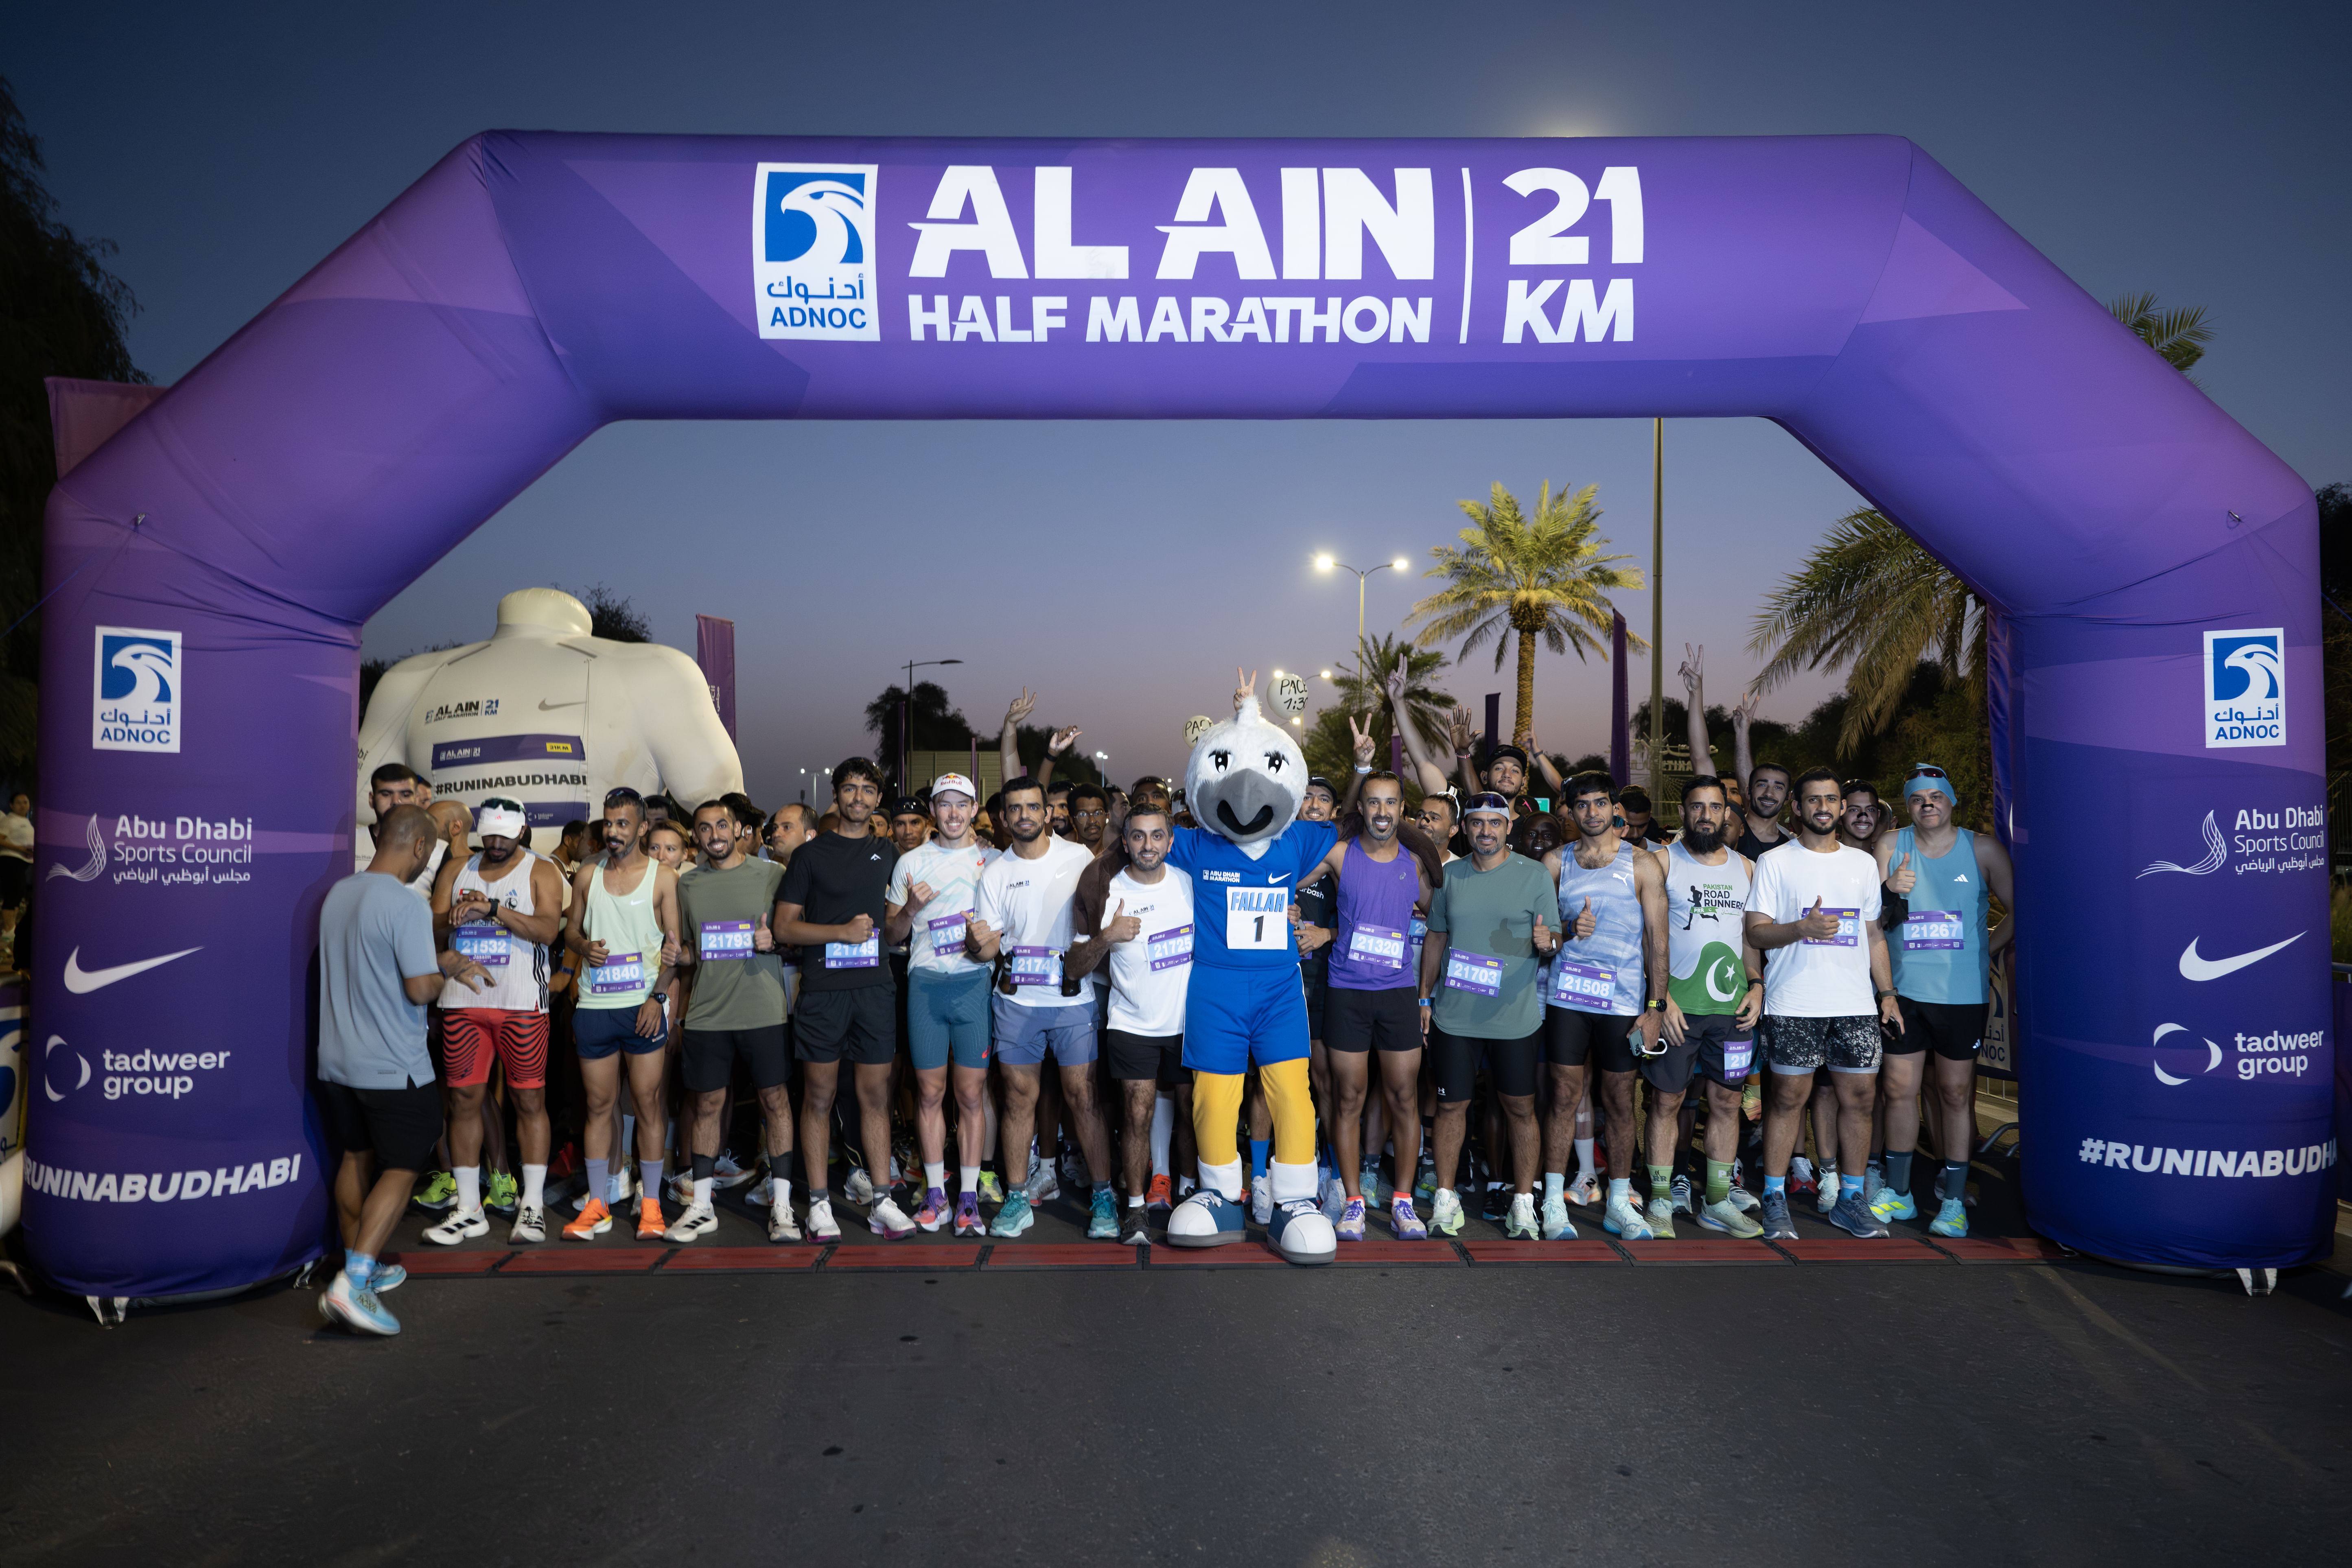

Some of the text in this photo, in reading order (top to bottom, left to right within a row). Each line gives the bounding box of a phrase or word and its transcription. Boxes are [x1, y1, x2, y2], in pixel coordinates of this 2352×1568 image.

[907, 166, 1433, 281] AL AIN
[1501, 166, 1644, 265] 21
[766, 271, 866, 304] أدنوك
[770, 306, 867, 330] ADNOC
[908, 295, 1433, 344] HALF MARATHON
[1502, 278, 1634, 344] KM
[454, 701, 480, 712] AIN
[486, 698, 499, 709] 21
[2214, 703, 2280, 725] أدنوك
[100, 707, 171, 728] أدنوك
[100, 727, 171, 745] ADNOC
[2214, 724, 2280, 740] ADNOC
[435, 774, 586, 795] #RUNINABUDHABI
[114, 814, 253, 841] Abu Dhabi
[2234, 805, 2324, 831] Abu Dhabi
[114, 841, 252, 864] Sports Council
[2234, 831, 2324, 856] Sports Council
[2235, 853, 2325, 875] مجلس أبوظبي الرياضي
[113, 866, 251, 886] مجلس أبوظبي الرياضي
[1230, 891, 1286, 912] FALLAH
[1704, 890, 1730, 899] ROAD
[1704, 899, 1744, 910] RUNNERS
[937, 925, 966, 944] 218
[1254, 915, 1264, 943] 1
[1911, 923, 1960, 938] 21267
[461, 939, 507, 954] 21532
[708, 933, 752, 948] 21793
[833, 940, 875, 956] 21745
[1154, 936, 1192, 958] 21725
[1357, 936, 1399, 956] 21320
[596, 965, 639, 982] 21840
[1017, 958, 1051, 972] 2174
[1454, 963, 1497, 984] 21703
[1564, 975, 1610, 997] 21508
[1984, 1024, 2004, 1042] أدن
[2234, 1030, 2324, 1053] tadweer
[103, 1048, 231, 1072] tadweer
[1731, 1051, 1752, 1068] 217
[1981, 1044, 2005, 1062] NOC
[2237, 1054, 2308, 1080] group
[103, 1075, 194, 1100] group
[2079, 1137, 2337, 1178] #RUNINABUDHA
[24, 1153, 302, 1203] RUNINABUDHABI
